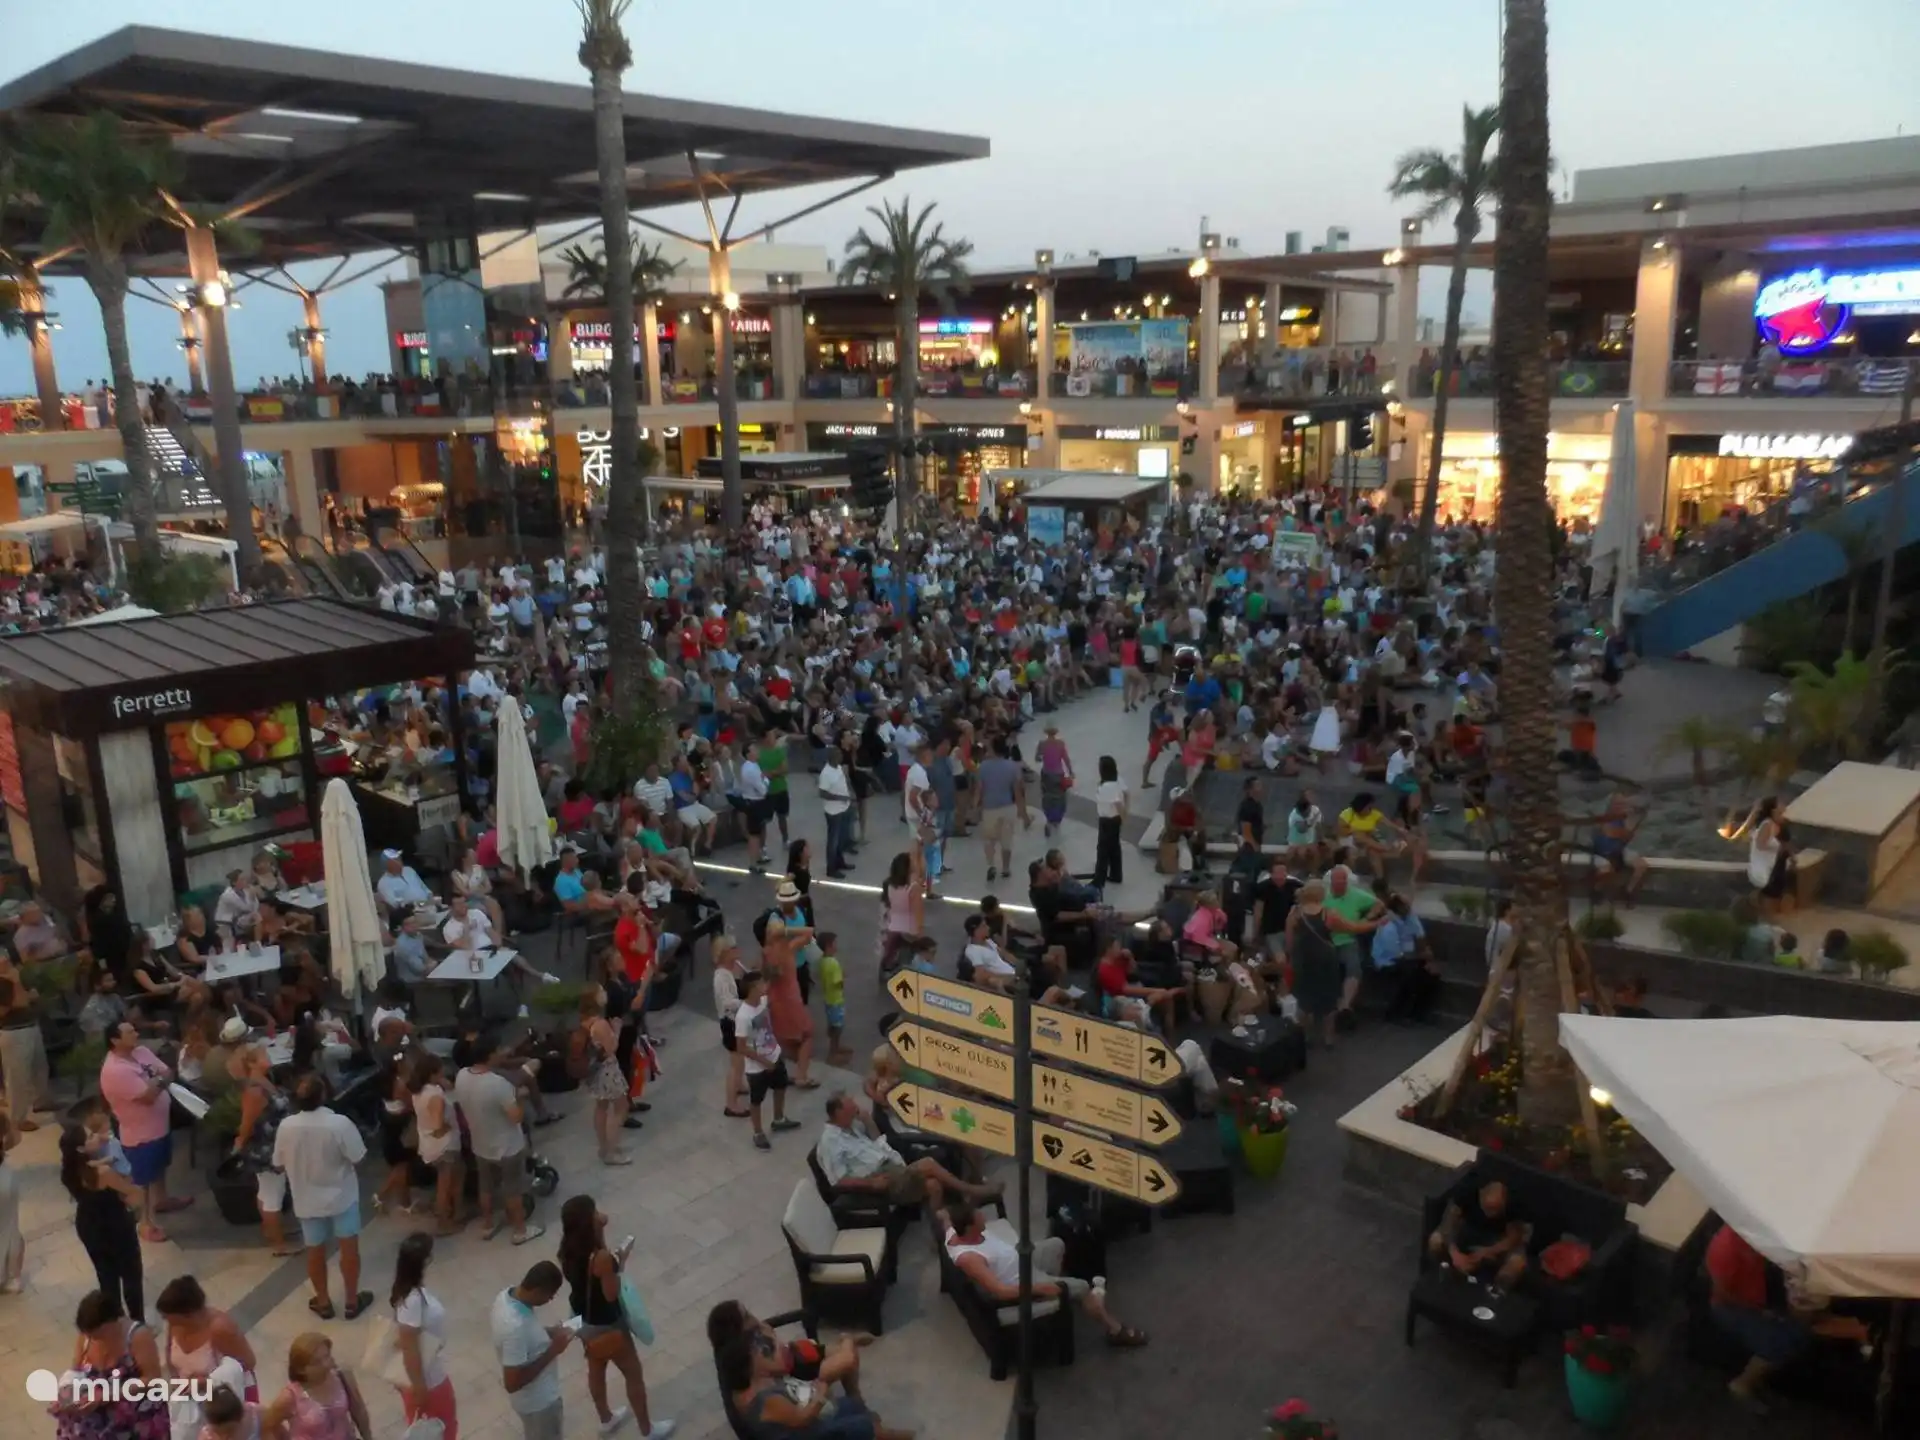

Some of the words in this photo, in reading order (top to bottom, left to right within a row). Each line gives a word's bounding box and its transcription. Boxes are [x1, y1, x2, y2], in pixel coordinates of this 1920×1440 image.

[825, 424, 846, 436] JACK
[852, 424, 878, 436] JONES
[113, 688, 192, 719] ferretti
[967, 1050, 1008, 1072] GUESS
